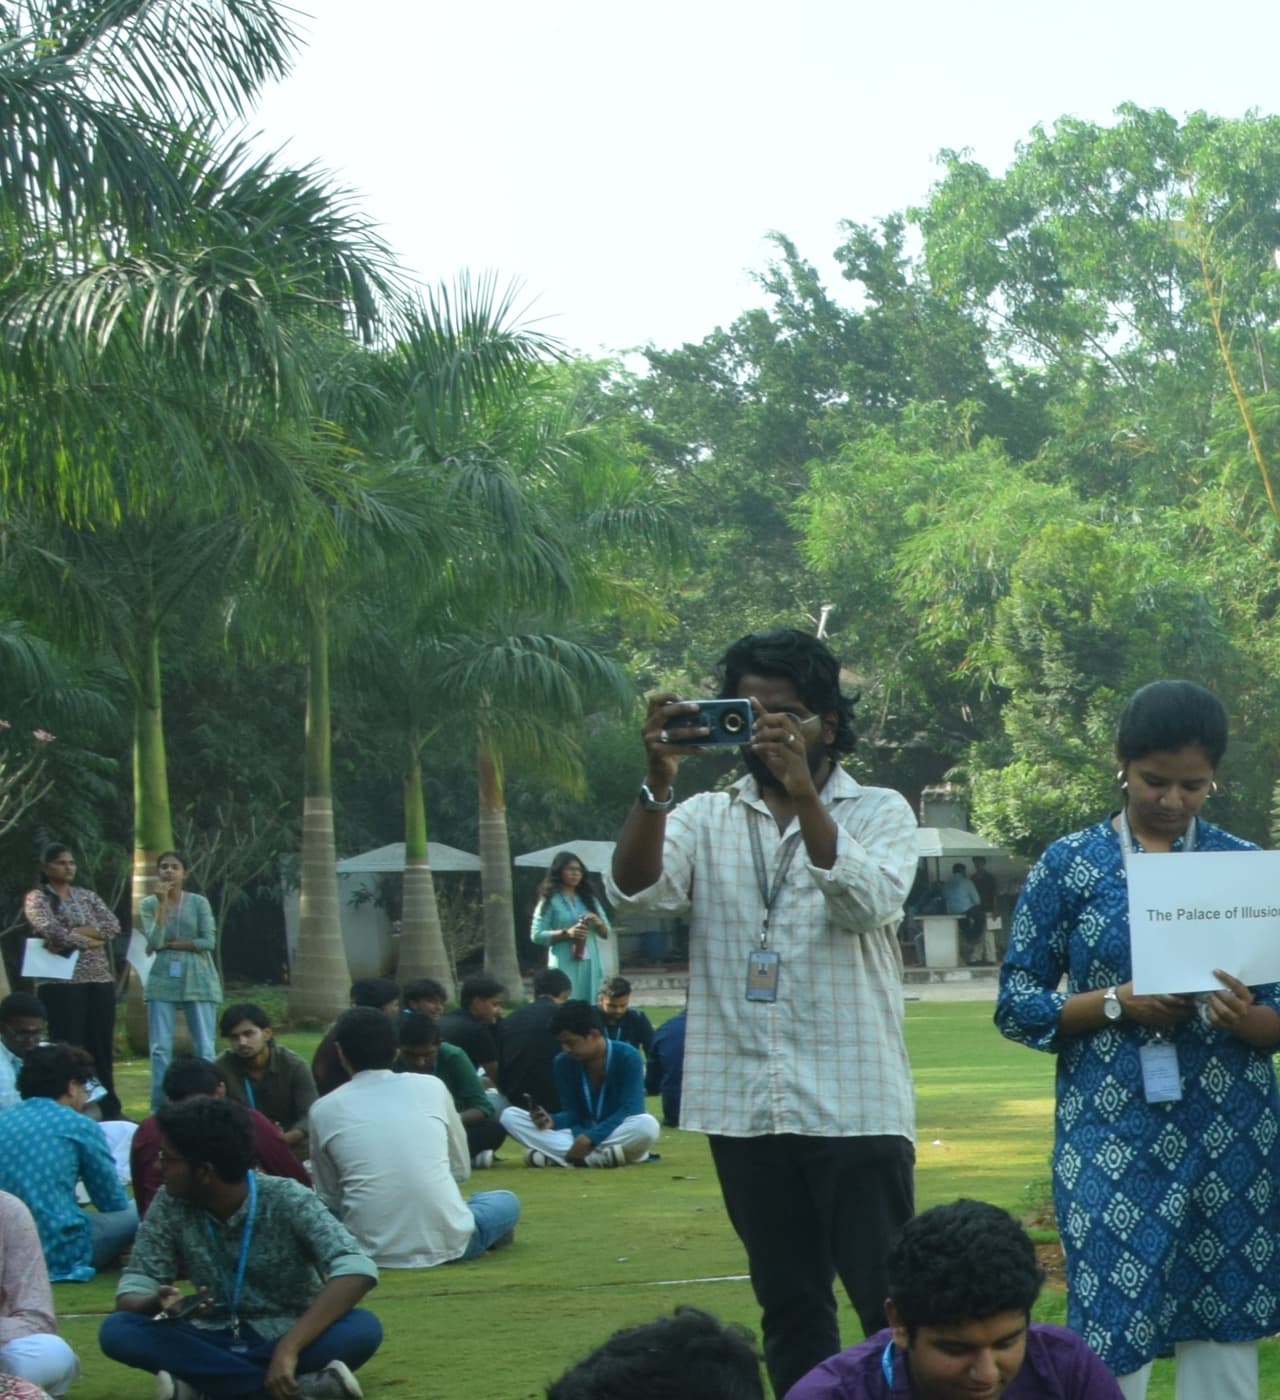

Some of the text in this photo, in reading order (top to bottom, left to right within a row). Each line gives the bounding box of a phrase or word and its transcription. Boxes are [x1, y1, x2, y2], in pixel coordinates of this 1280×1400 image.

[1146, 909, 1173, 921] The
[1177, 908, 1221, 921] Palace
[1225, 906, 1238, 919] of
